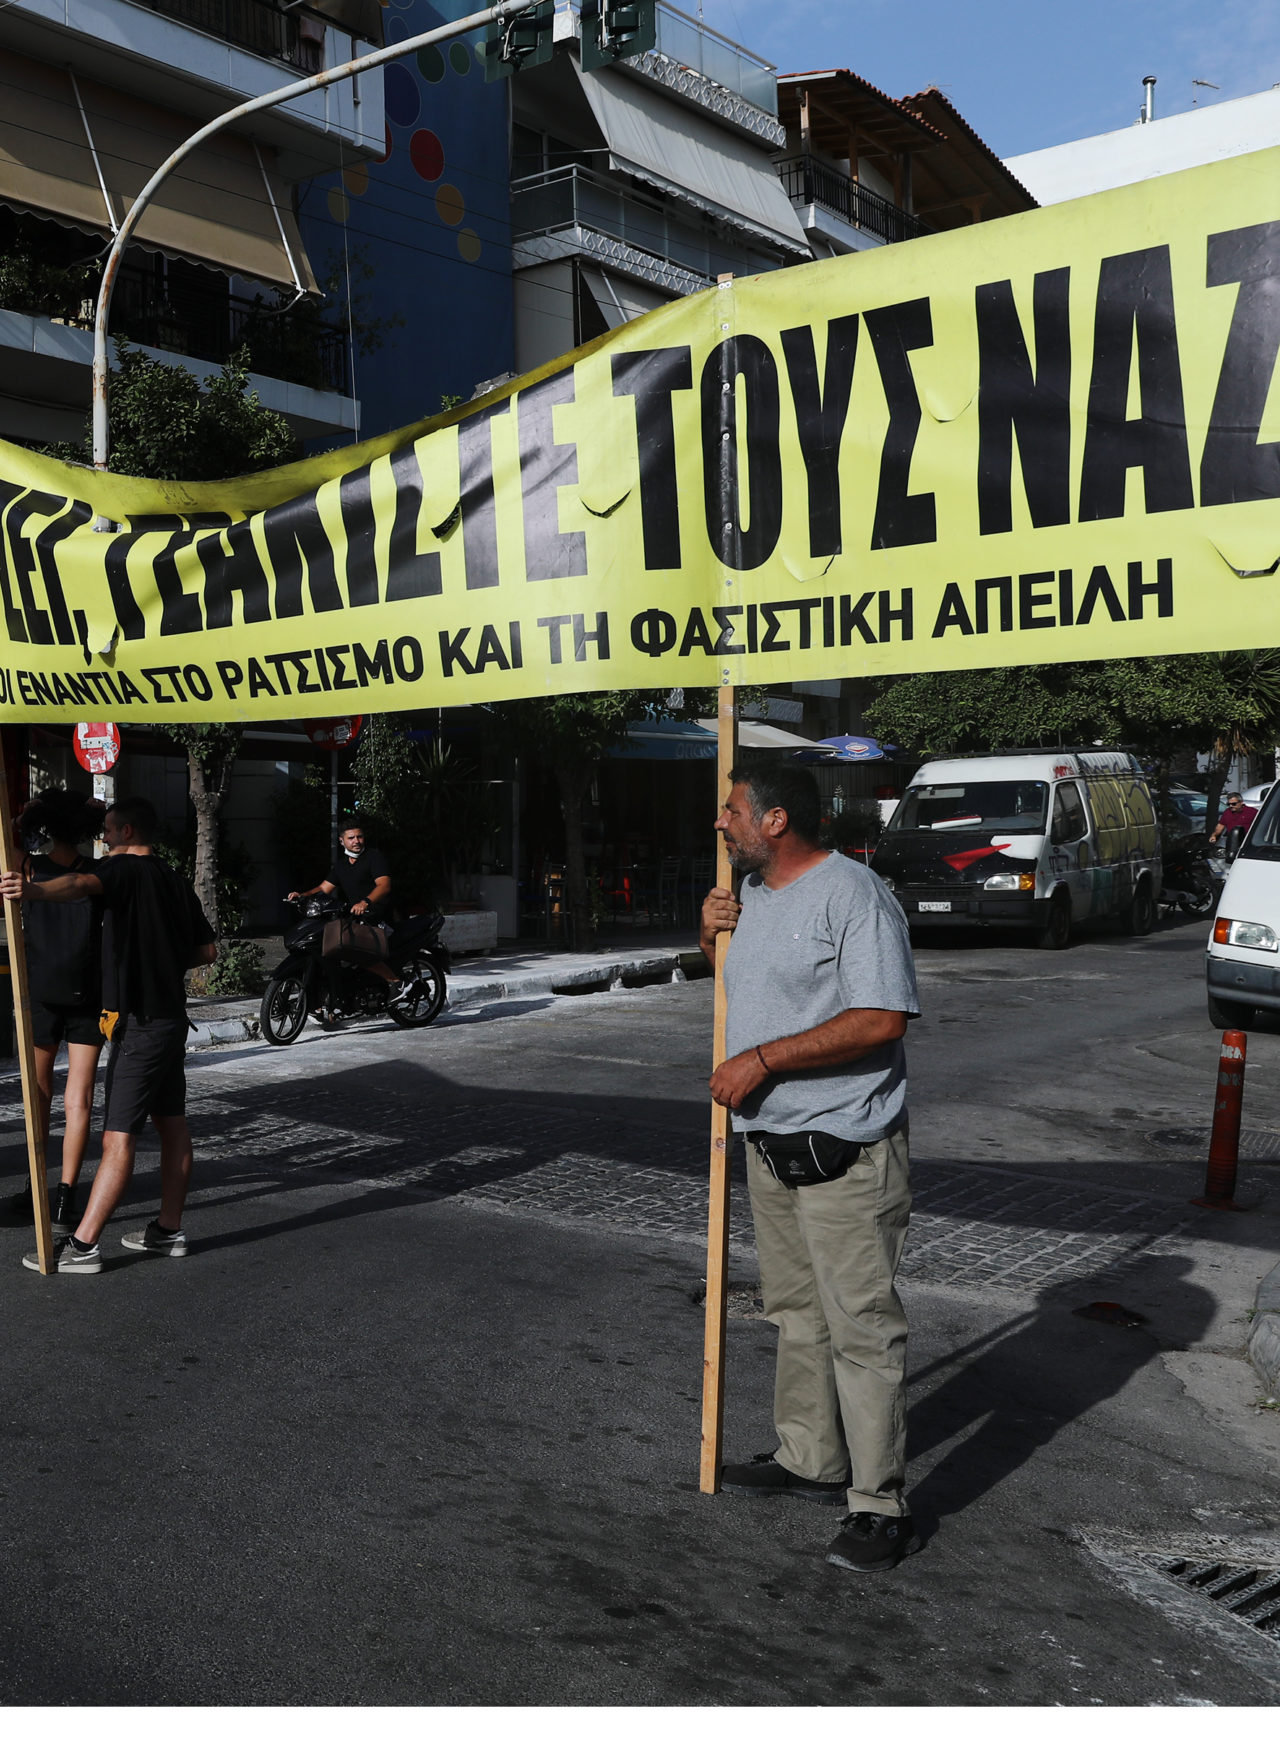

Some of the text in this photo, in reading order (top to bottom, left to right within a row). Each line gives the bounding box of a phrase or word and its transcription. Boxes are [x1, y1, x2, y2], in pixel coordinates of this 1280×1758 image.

[611, 297, 938, 572] ΤΟΥΣ
[18, 670, 146, 706] ΕΝΑΝΤΙΑ
[141, 663, 213, 704] ΣΤΟ
[216, 634, 424, 699] ΡΑΤΣΙΣΜΟ
[438, 620, 523, 678] ΚΑΙ
[536, 610, 610, 665] ΤΗ
[629, 588, 915, 658] ΦΑΣΙΣΤΙΚΗ
[933, 557, 1175, 638] ΑΠΕΙΛΗ
